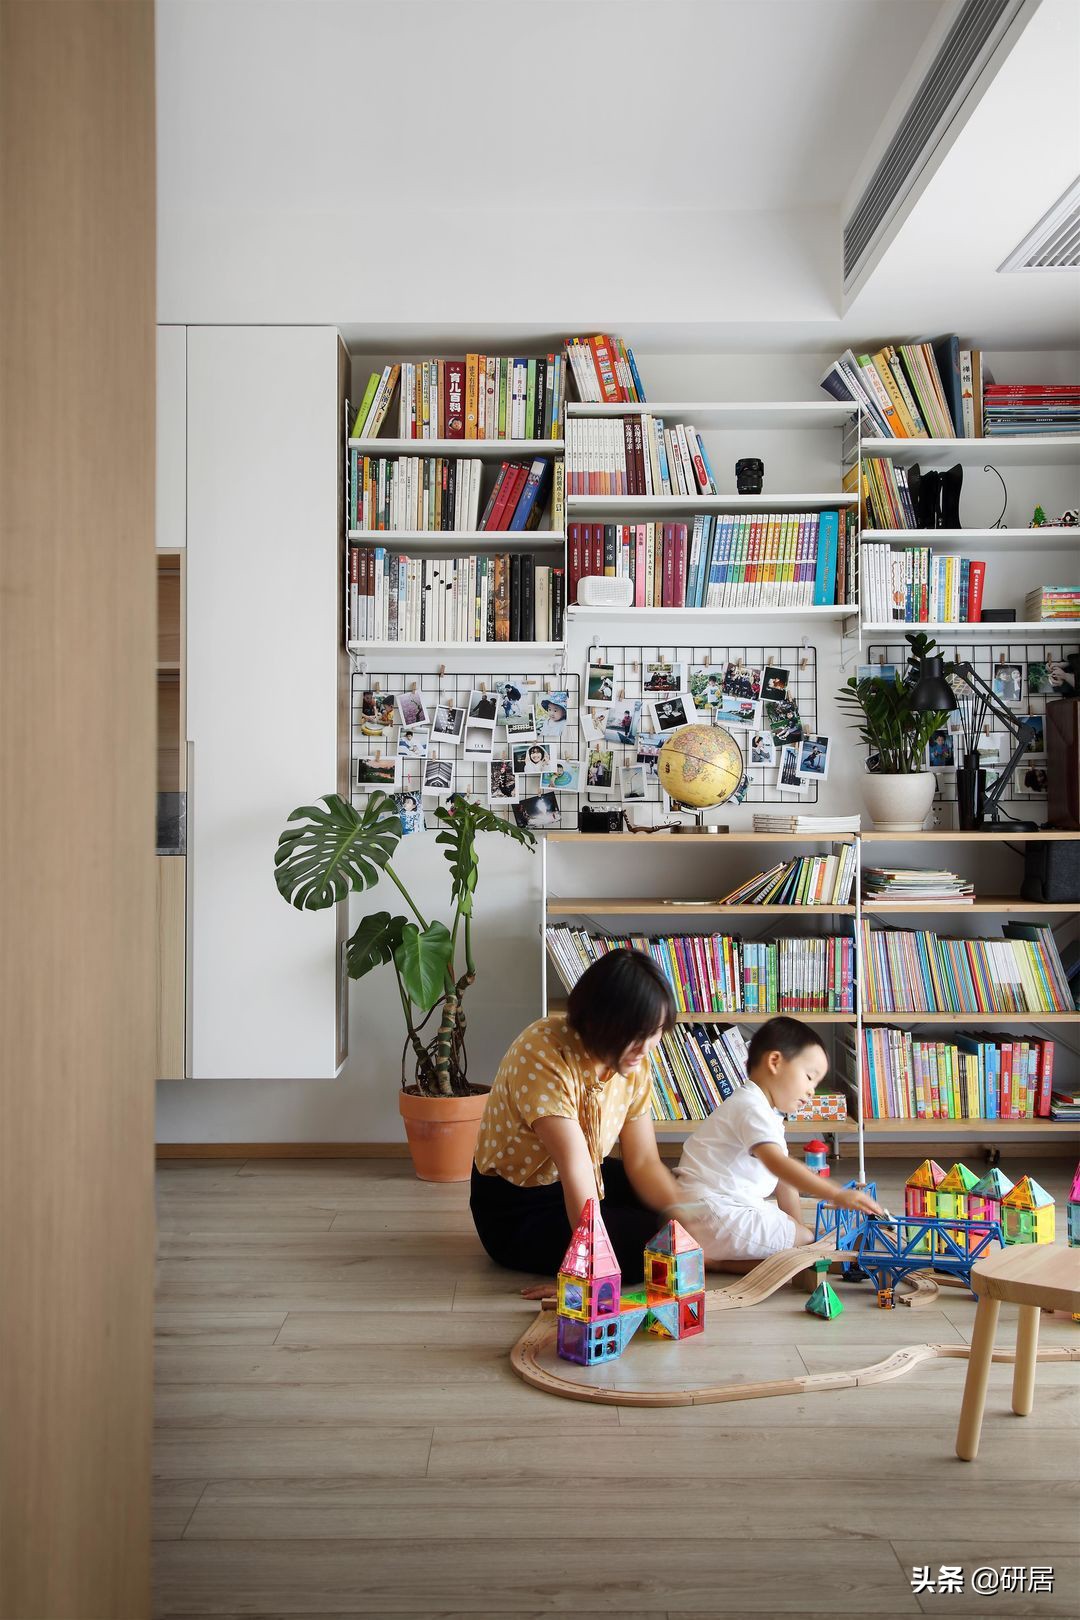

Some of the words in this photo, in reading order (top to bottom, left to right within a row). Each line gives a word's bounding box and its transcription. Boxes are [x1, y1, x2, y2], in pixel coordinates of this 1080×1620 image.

[449, 372, 462, 413] 育儿百科
[710, 1058, 731, 1097] 我们的太空
